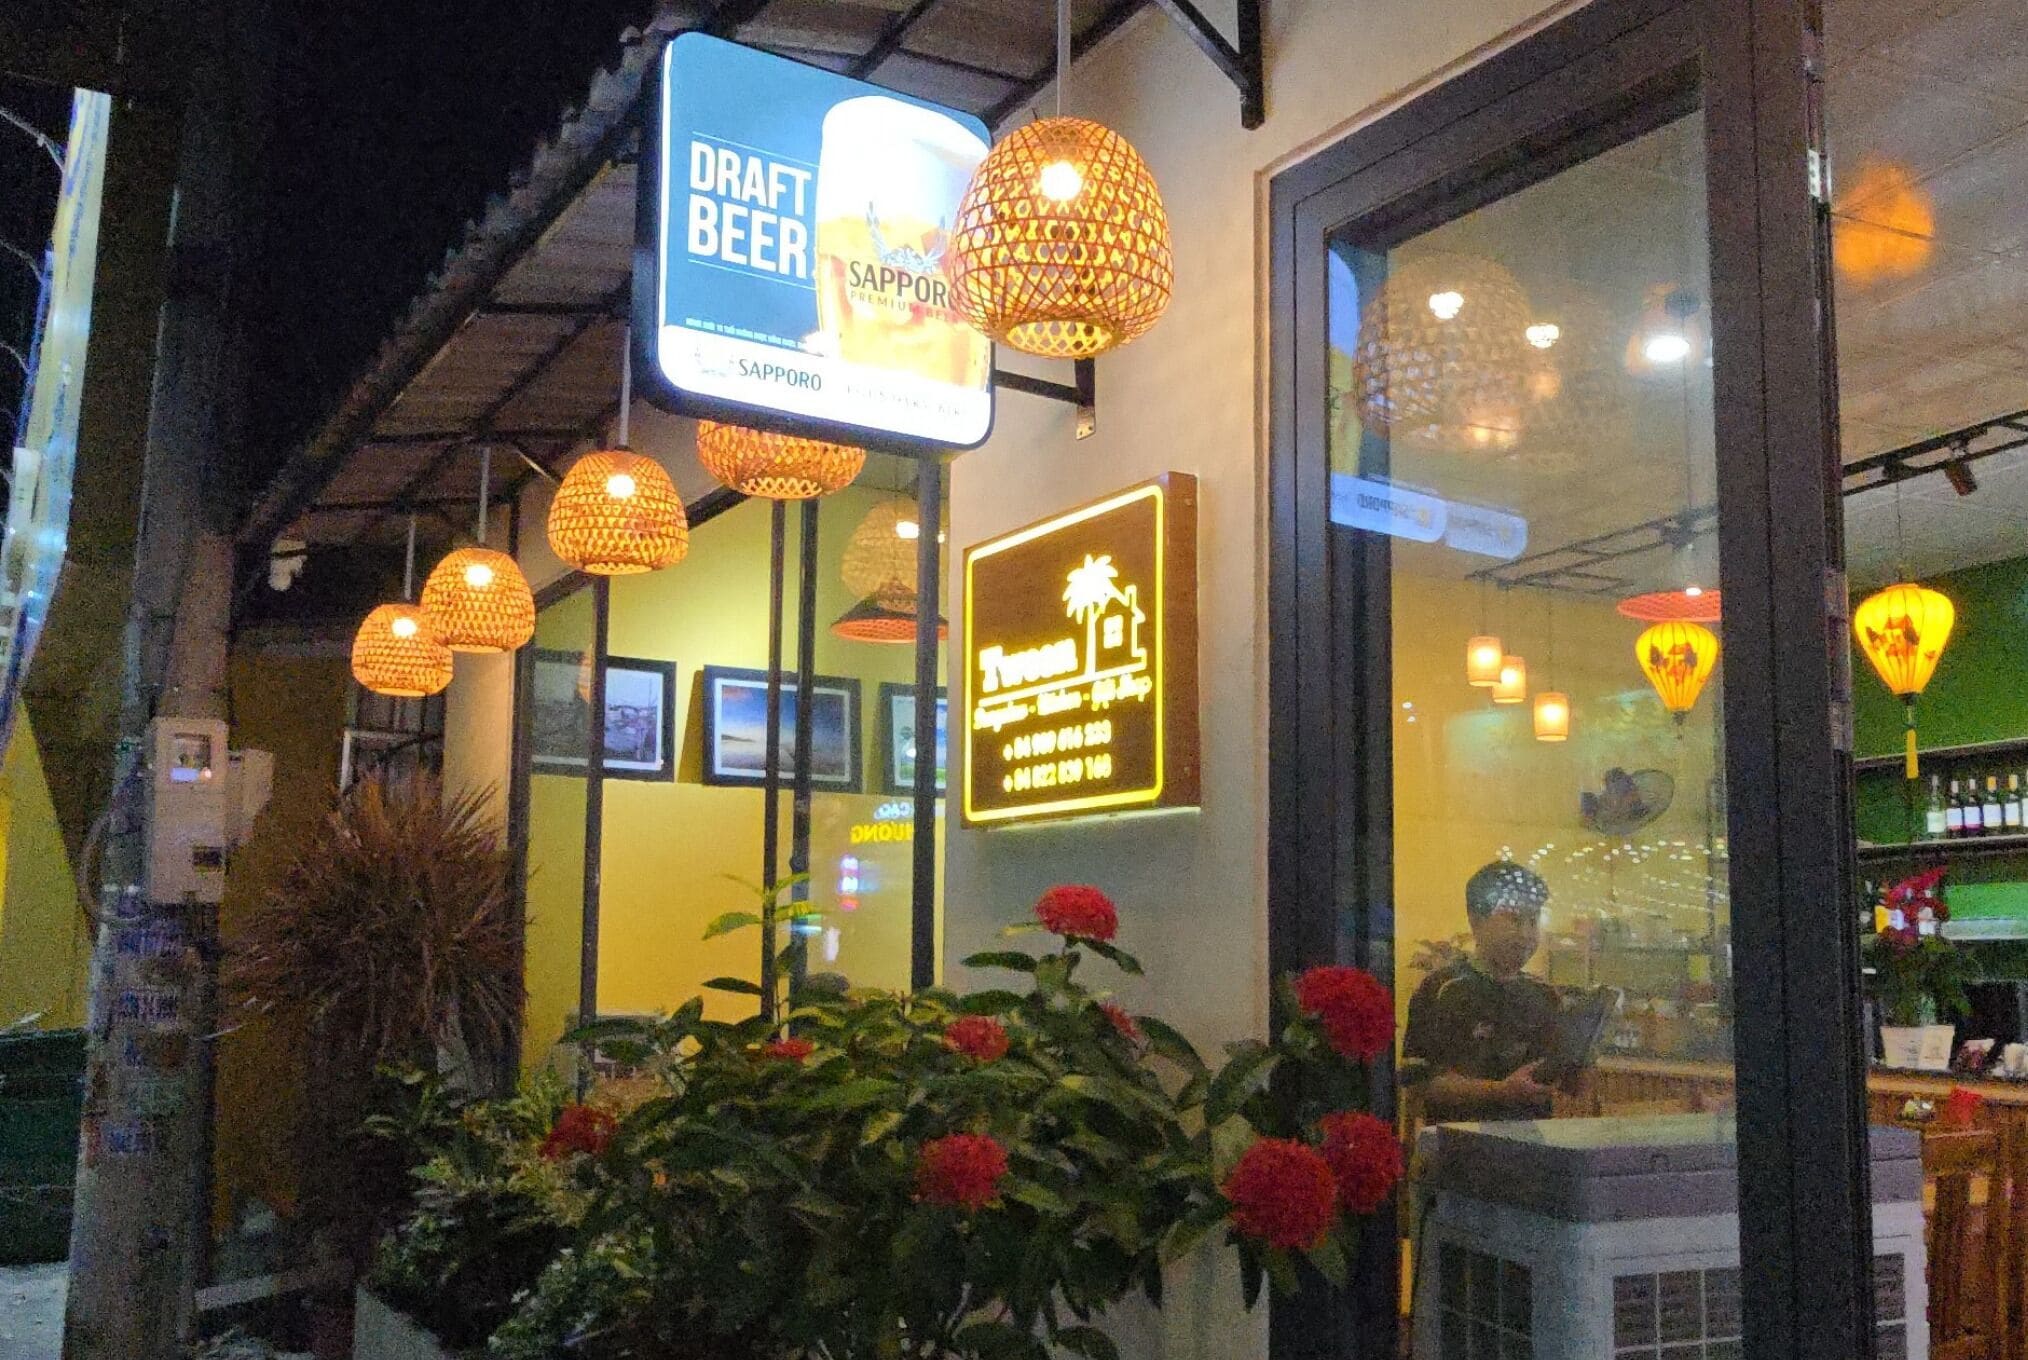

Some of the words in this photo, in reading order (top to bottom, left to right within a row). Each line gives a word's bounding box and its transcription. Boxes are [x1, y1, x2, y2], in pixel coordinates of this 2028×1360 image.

[690, 140, 812, 217] DRAFT
[688, 193, 808, 280] BEER
[739, 357, 822, 393] SAPPORO
